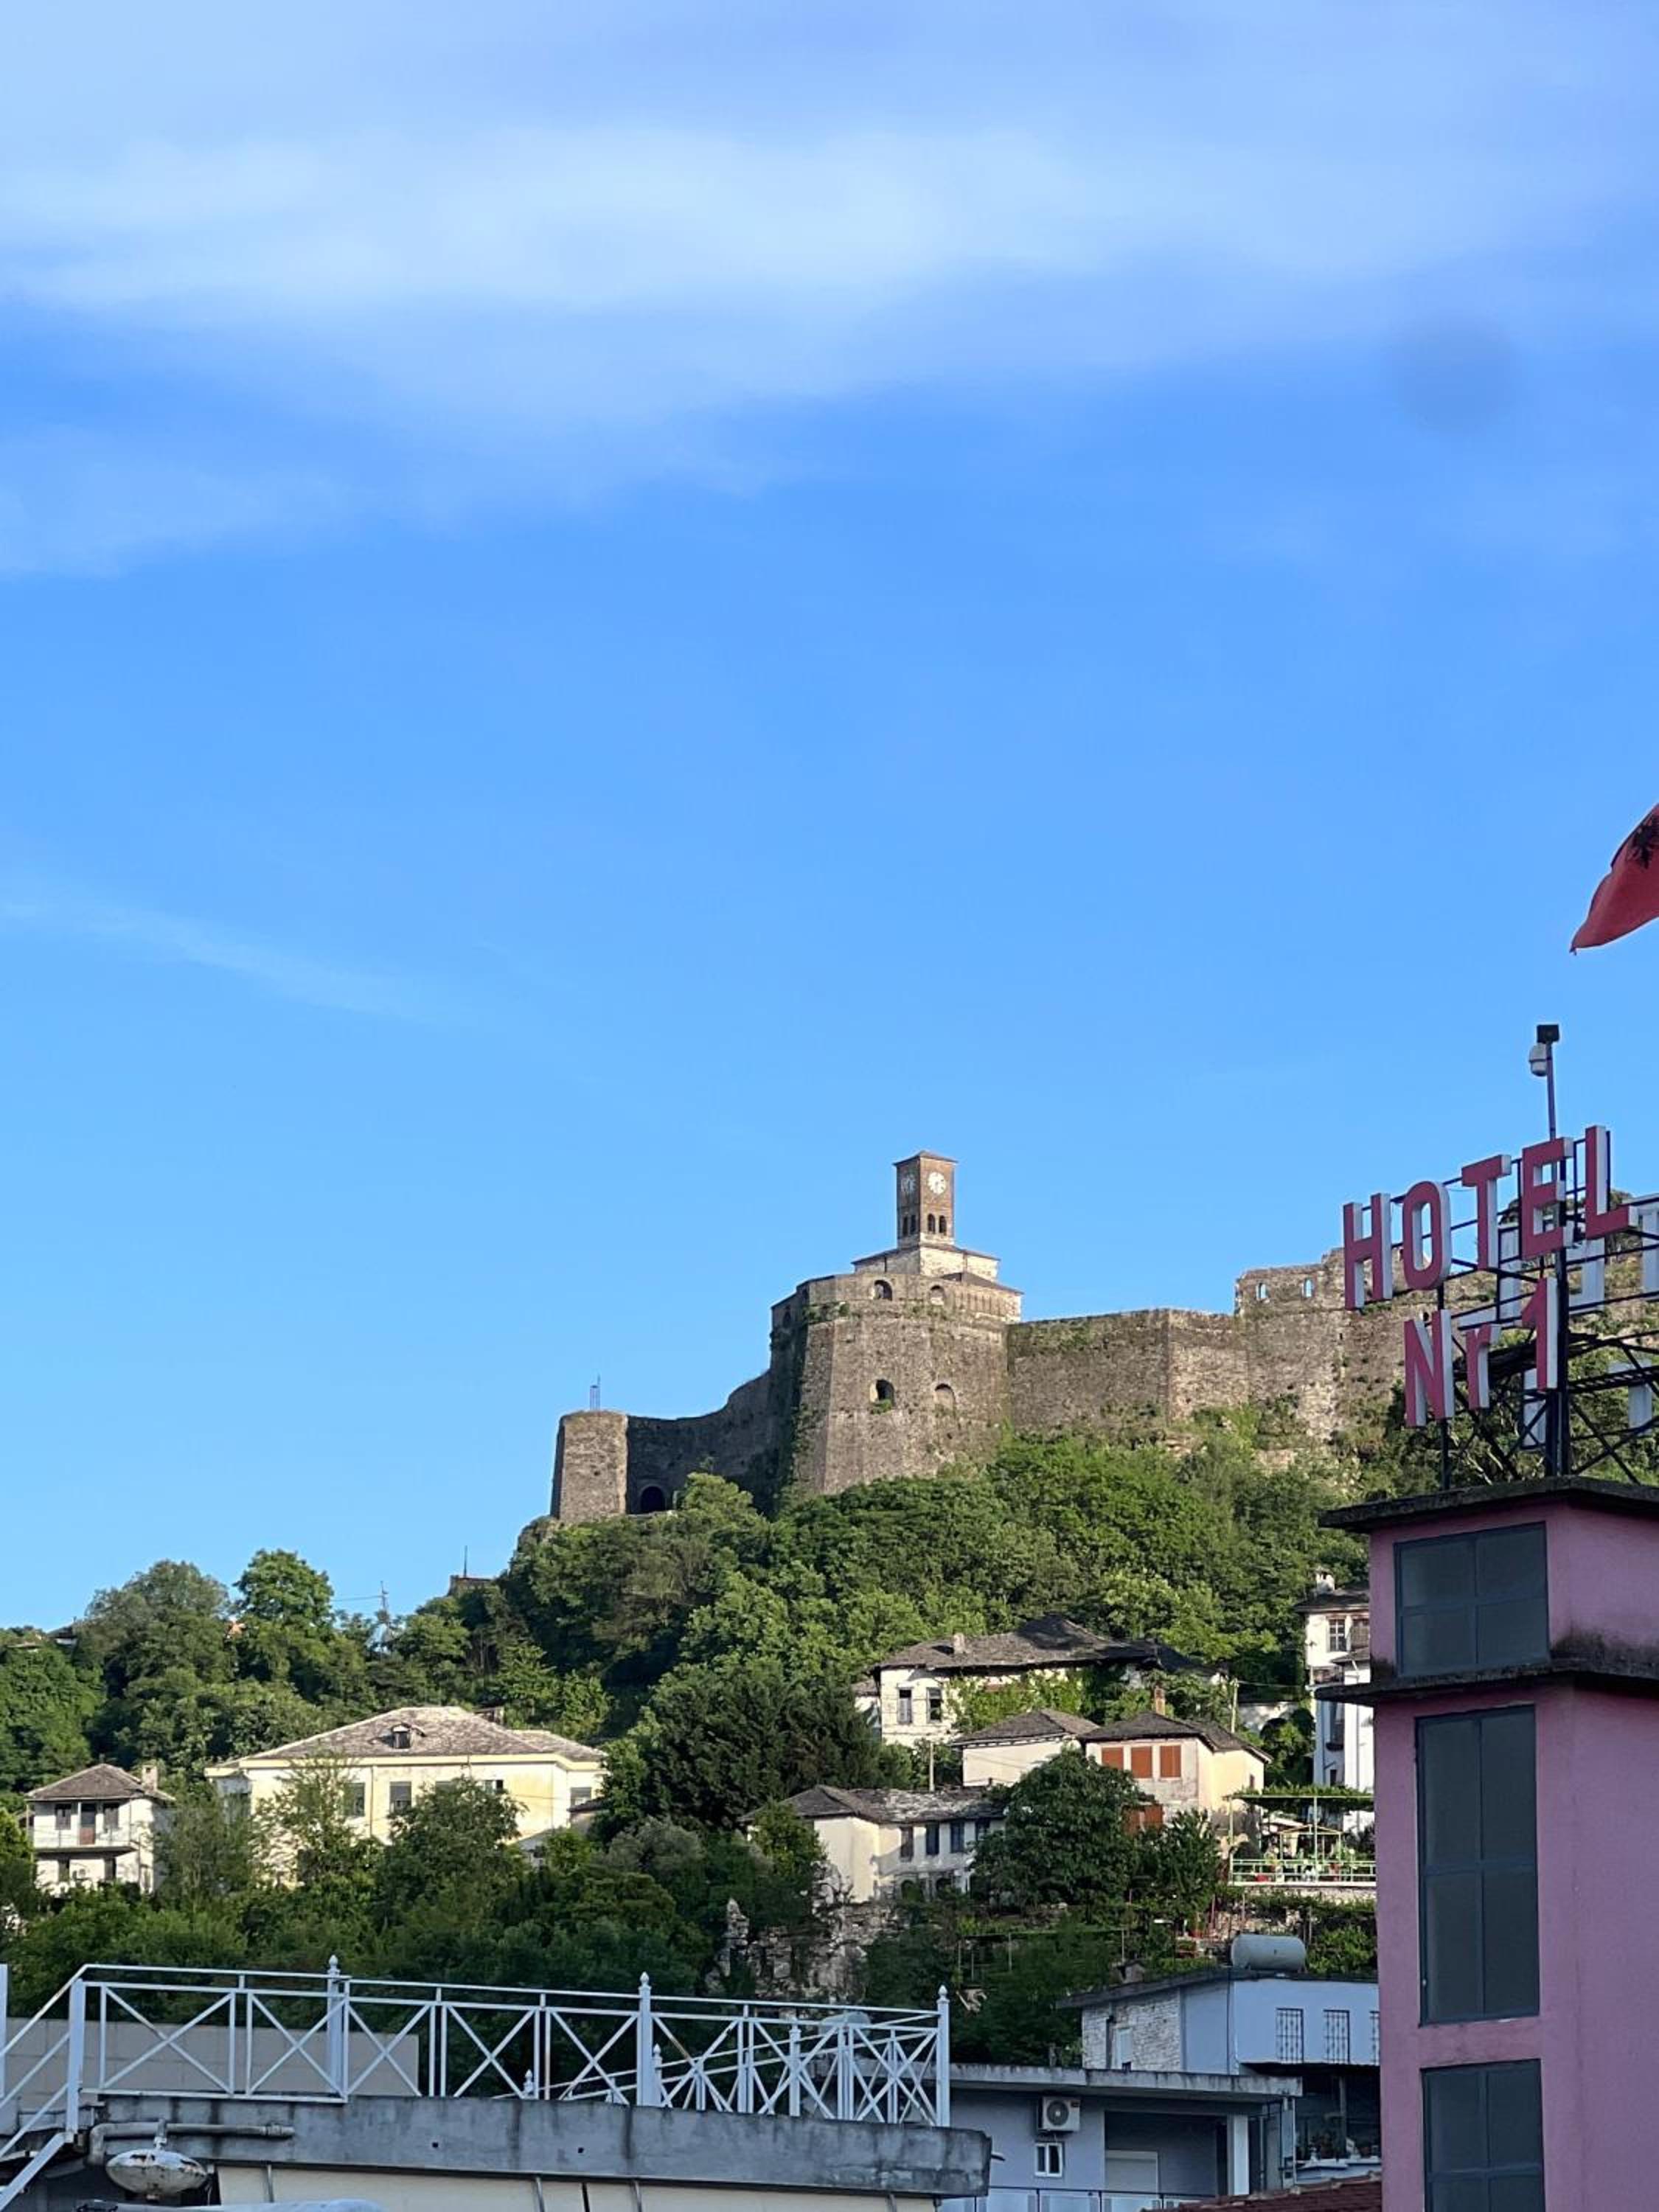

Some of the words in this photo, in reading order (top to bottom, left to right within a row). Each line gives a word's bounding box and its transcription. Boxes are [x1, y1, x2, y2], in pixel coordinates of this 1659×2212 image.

[1343, 1124, 1638, 1310] HOTEL
[1404, 1309, 1501, 1427] Nr
[1521, 1276, 1559, 1392] 1
